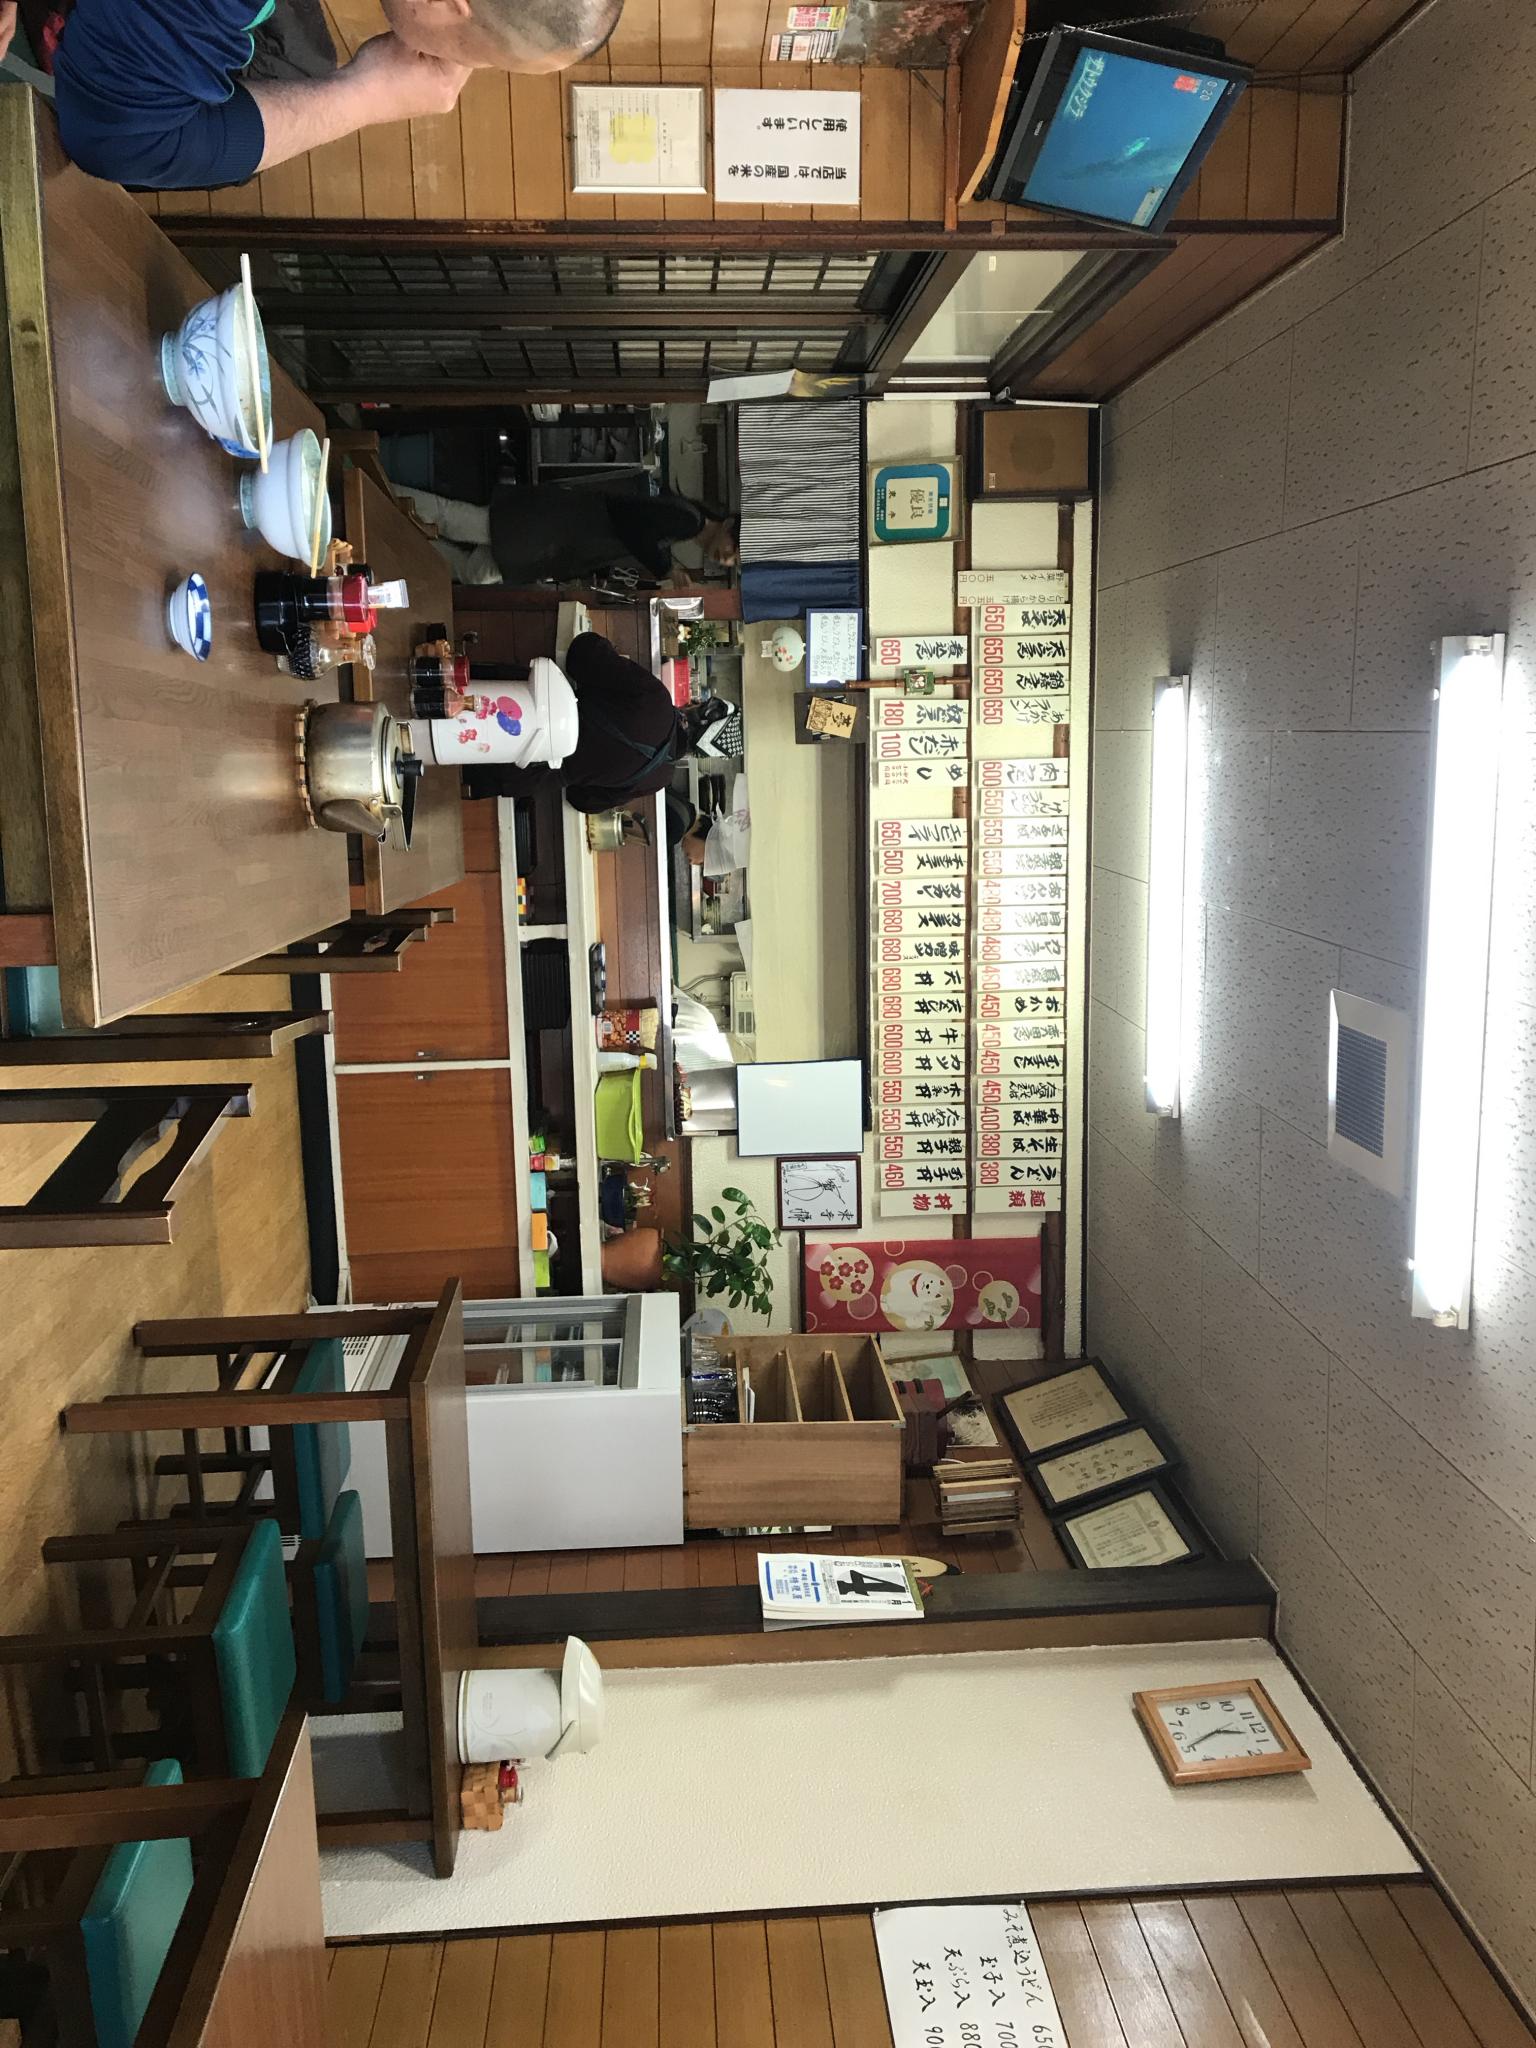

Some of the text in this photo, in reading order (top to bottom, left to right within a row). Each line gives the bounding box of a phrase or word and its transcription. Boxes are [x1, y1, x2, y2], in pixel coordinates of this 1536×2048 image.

[1068, 57, 1104, 119] ザトウクジラ
[756, 117, 848, 132] 使用しています。
[728, 163, 847, 180] 当店では、国産の米を
[910, 489, 925, 520] 優良
[984, 606, 1066, 632] 天ぷらそば 650
[881, 639, 963, 665] 煮込うどん 650
[984, 638, 1066, 664] 天ぷらうどん 650
[984, 669, 1064, 694] 鍋焼うどん 650
[884, 701, 904, 726] 180
[984, 699, 1064, 724] あんかけ ラーメン 650
[881, 733, 901, 758] 100
[916, 764, 963, 781] めし
[983, 762, 1002, 786] 600
[984, 790, 1003, 815] 550
[882, 822, 962, 846] エビフライ 650
[984, 820, 1003, 844] 550
[884, 850, 964, 874] チキンライス 500
[983, 851, 1002, 874] 550
[882, 881, 961, 905] カツカレー 700
[883, 910, 961, 932] カツライス 680
[982, 908, 1001, 931] 480
[882, 939, 901, 962] 680
[914, 941, 960, 959] 味噌カツ
[981, 937, 1000, 960] 480
[882, 968, 961, 991] 天丼 680
[882, 996, 902, 1018] 680
[981, 994, 1060, 1017] おかめ 450
[884, 1024, 958, 1048] 牛丼 600
[982, 1024, 1001, 1047] 450
[882, 1051, 962, 1074] カツ丼 600
[981, 1050, 1000, 1074] 450
[882, 1080, 902, 1103] 550
[982, 1080, 1000, 1103] 450
[882, 1107, 960, 1131] たぬき丼 550
[981, 1106, 1059, 1130] 中華そば 400
[884, 1136, 962, 1159] 親子丼 550
[981, 1134, 1058, 1156] 生そば 380
[885, 1164, 904, 1187] 460
[980, 1162, 1057, 1184] うどん 380
[912, 1193, 952, 1211] 丼物
[837, 1570, 906, 1596] 4
[1175, 1707, 1190, 1716] 8
[1196, 1702, 1211, 1710] 9
[1219, 1700, 1235, 1712] 10
[1172, 1732, 1187, 1741] 6
[1248, 1722, 1266, 1733] 12
[1002, 1909, 1044, 2008] みそ煮込うどん
[943, 1946, 971, 2009] 天ぷら入
[912, 1959, 944, 2048] 天玉入 90
[980, 1956, 1019, 2048] 玉子入 700
